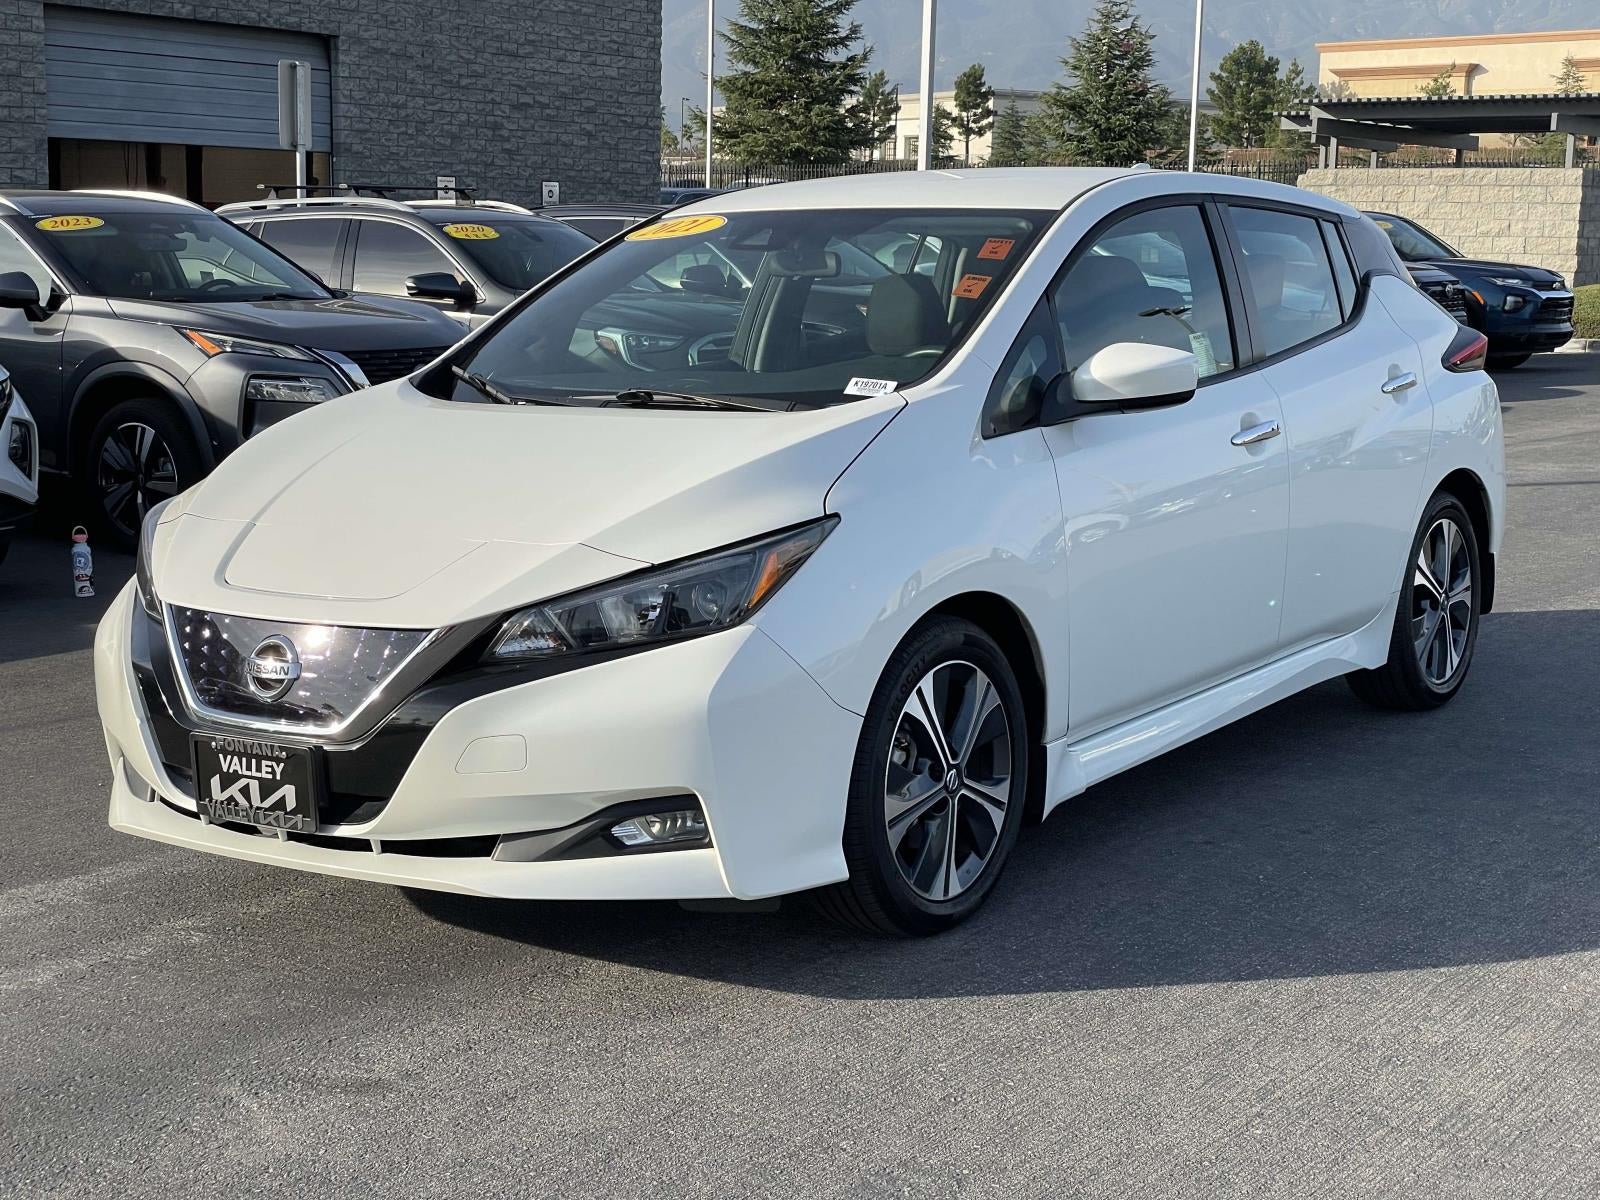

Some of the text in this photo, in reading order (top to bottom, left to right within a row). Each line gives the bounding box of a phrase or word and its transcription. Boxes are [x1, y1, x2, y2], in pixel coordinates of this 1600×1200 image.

[50, 217, 92, 229] 2023
[247, 660, 290, 676] NISSAN
[215, 736, 286, 758] FONTANA
[218, 753, 285, 780] VALLEY
[210, 773, 297, 812] KIA
[205, 798, 303, 831] VALLEY KIA
